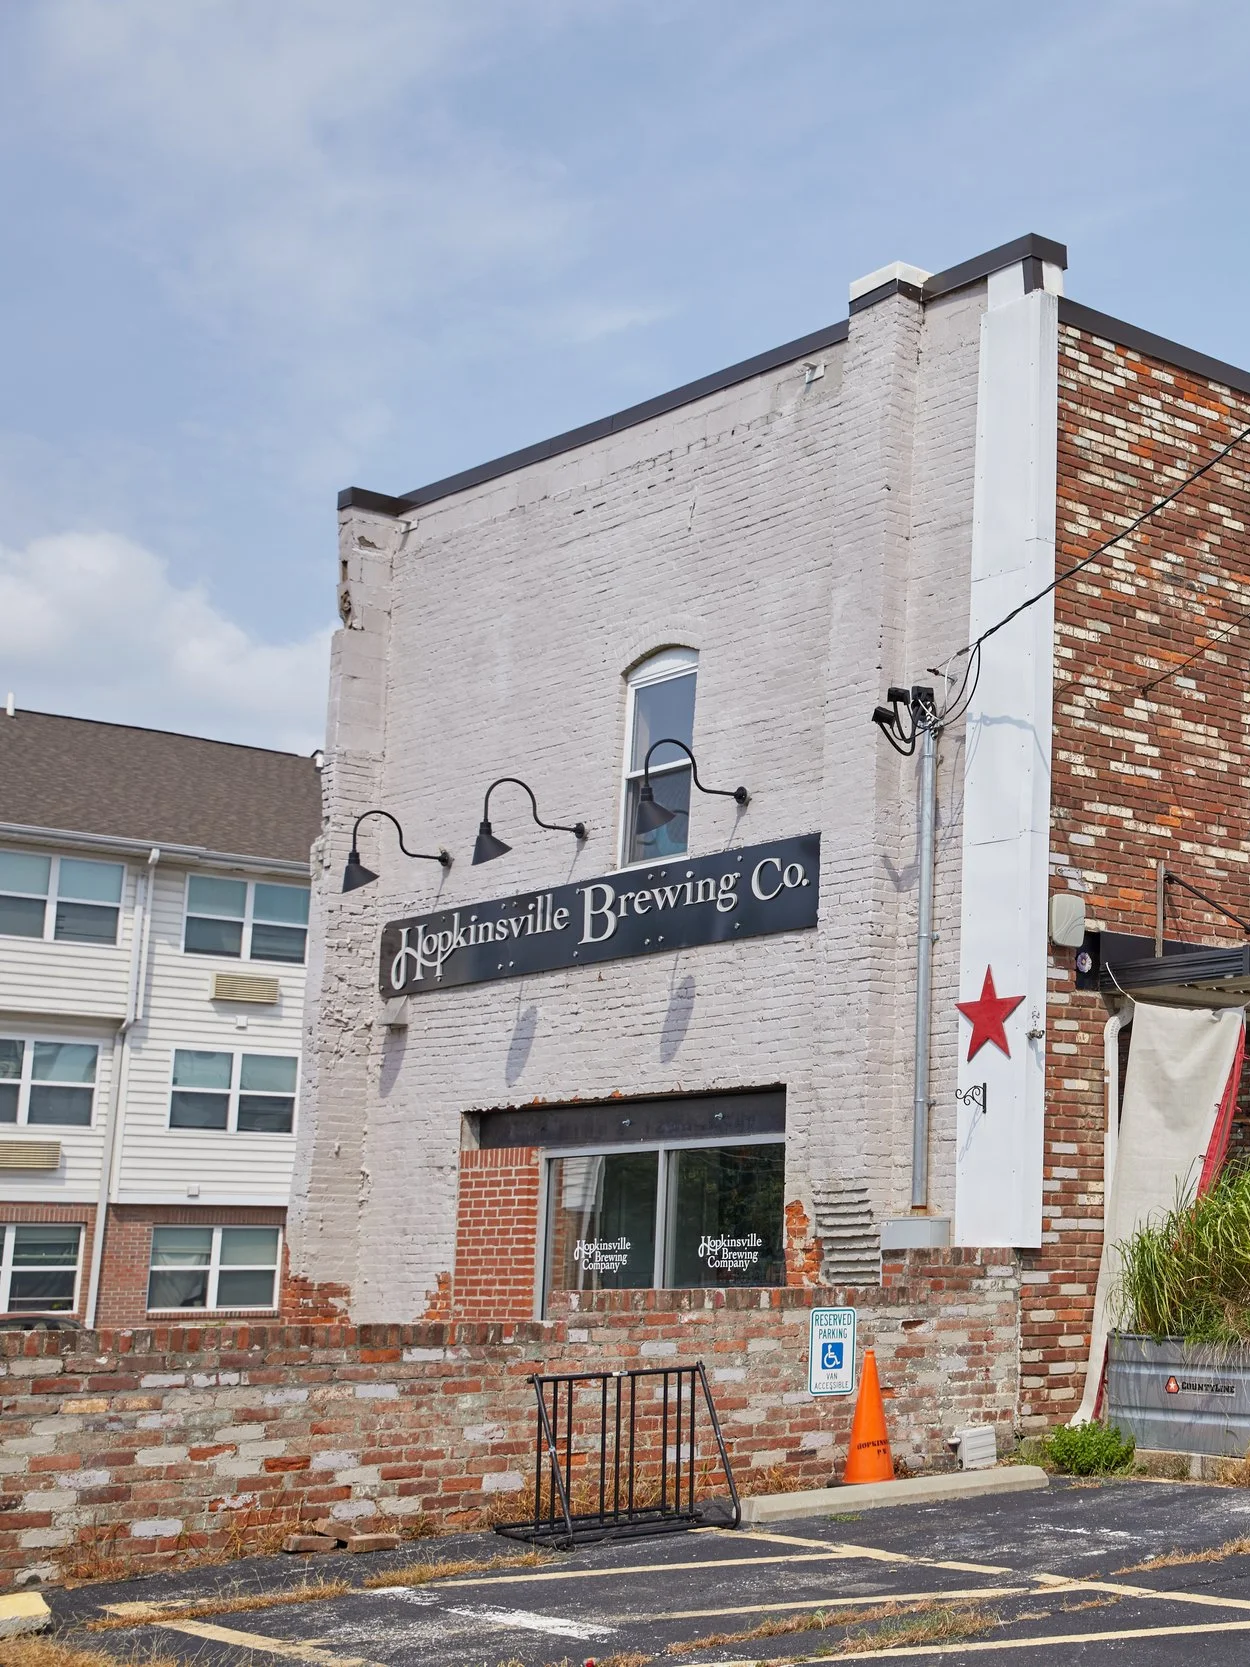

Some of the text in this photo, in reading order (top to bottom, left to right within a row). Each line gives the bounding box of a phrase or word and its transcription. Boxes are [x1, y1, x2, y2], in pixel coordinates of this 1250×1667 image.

[391, 857, 810, 990] Hopkinsville Brewing Co.
[573, 1236, 631, 1260] Hopkinsville
[698, 1233, 762, 1258] Hopkinsville
[594, 1250, 628, 1265] Brewing
[721, 1247, 759, 1263] Brewing
[582, 1258, 620, 1273] Company
[707, 1255, 751, 1272] Company
[814, 1313, 852, 1327] RESERVED
[818, 1328, 848, 1340] PARKING
[826, 1372, 838, 1380] VAN
[814, 1380, 849, 1390] ACCESSIBLE
[1181, 1381, 1235, 1394] COUNTYLINE
